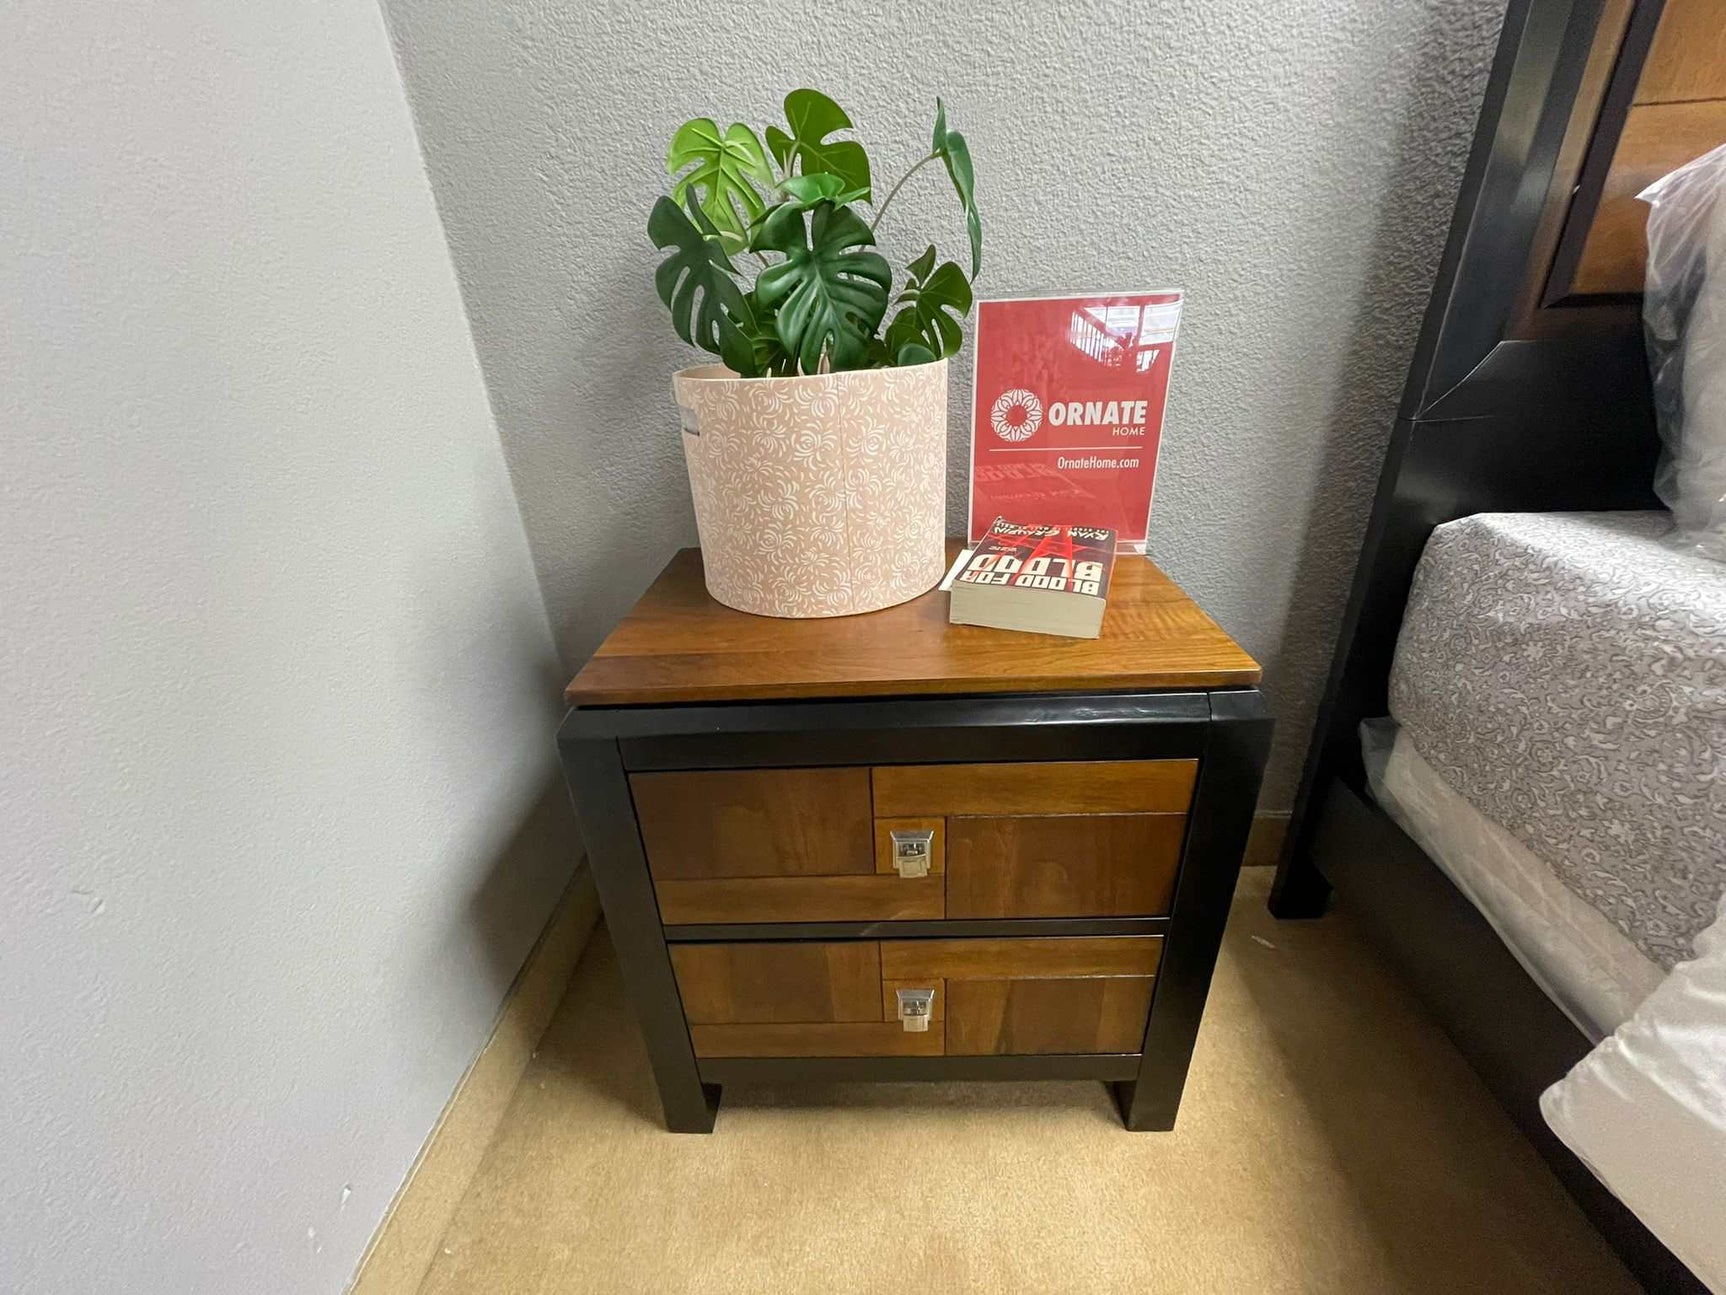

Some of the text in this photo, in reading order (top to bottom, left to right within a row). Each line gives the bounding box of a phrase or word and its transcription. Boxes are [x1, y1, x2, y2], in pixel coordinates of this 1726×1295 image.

[1049, 401, 1147, 426] ORNATE
[1112, 426, 1146, 436] HOME
[1057, 456, 1140, 471] OrnateHome.com
[1067, 530, 1108, 541] RYAN
[968, 555, 1103, 581] BLOOD
[960, 571, 1099, 595] BLOOD FOR
